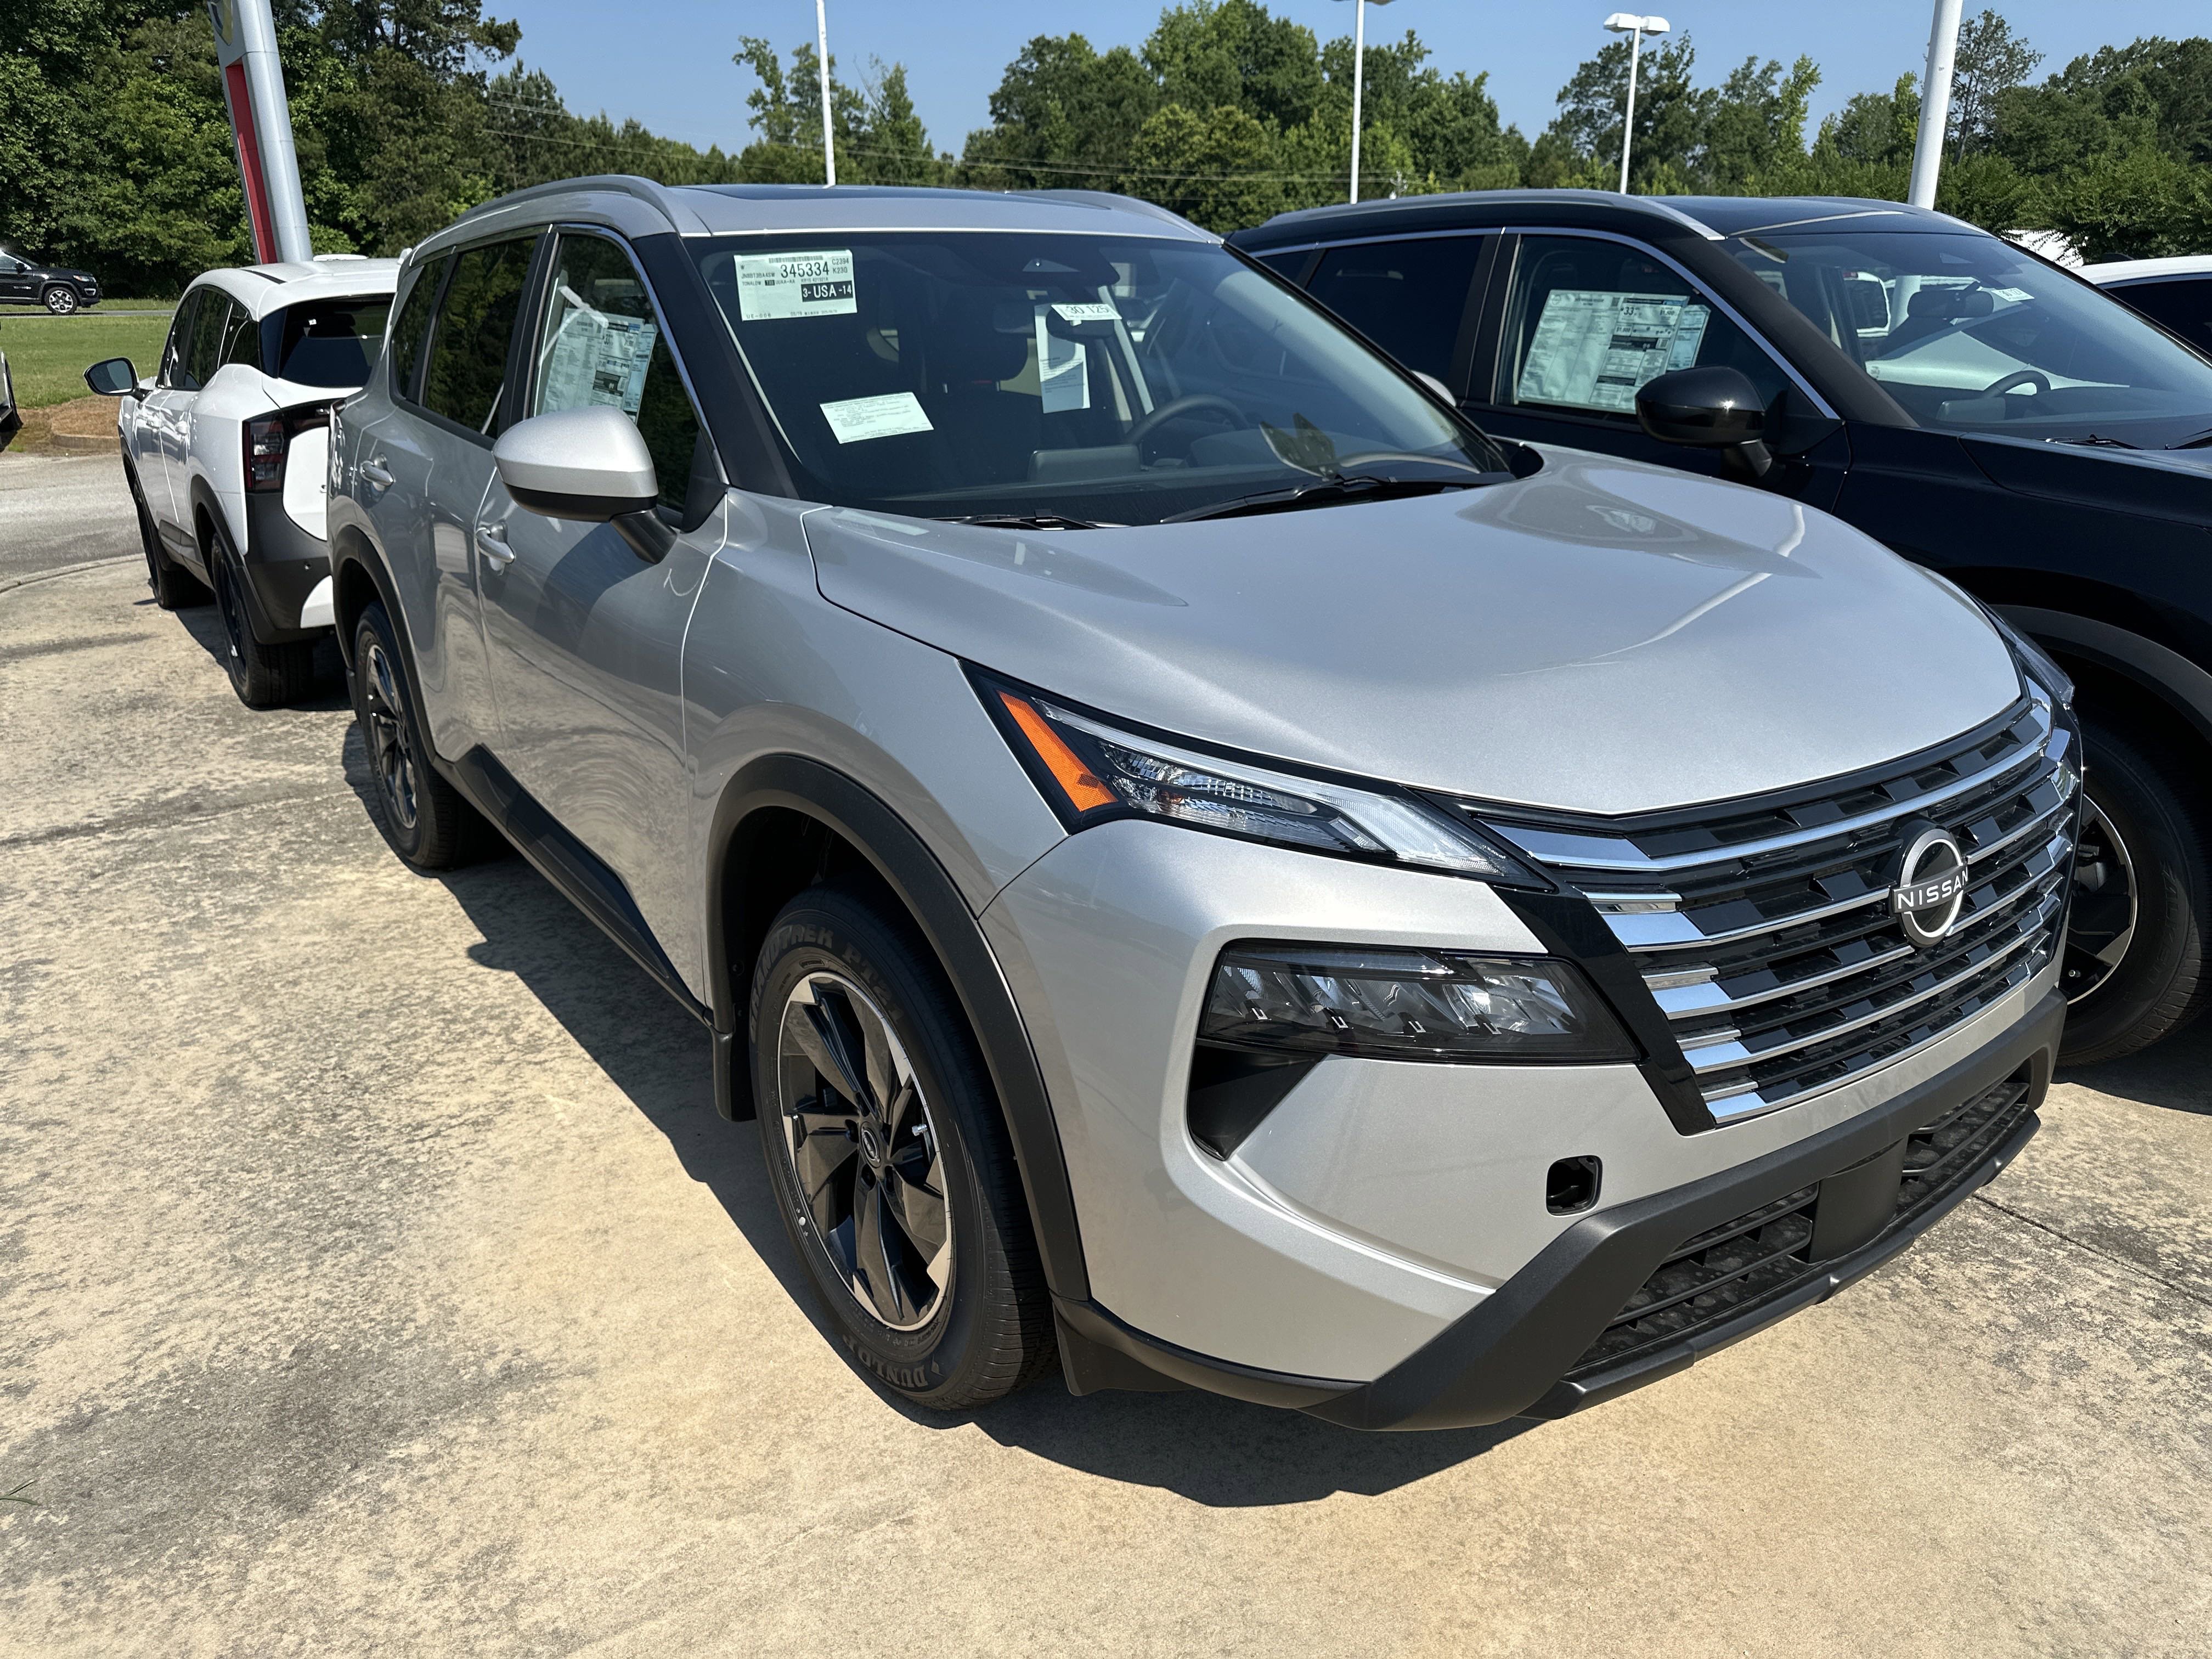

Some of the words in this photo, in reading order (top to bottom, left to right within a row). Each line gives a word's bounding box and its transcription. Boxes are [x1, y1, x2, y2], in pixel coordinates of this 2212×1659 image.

[780, 261, 830, 278] 345334
[813, 285, 837, 298] USA
[1898, 868, 1968, 909] NISSAN
[842, 1334, 928, 1387] DUNLOP
